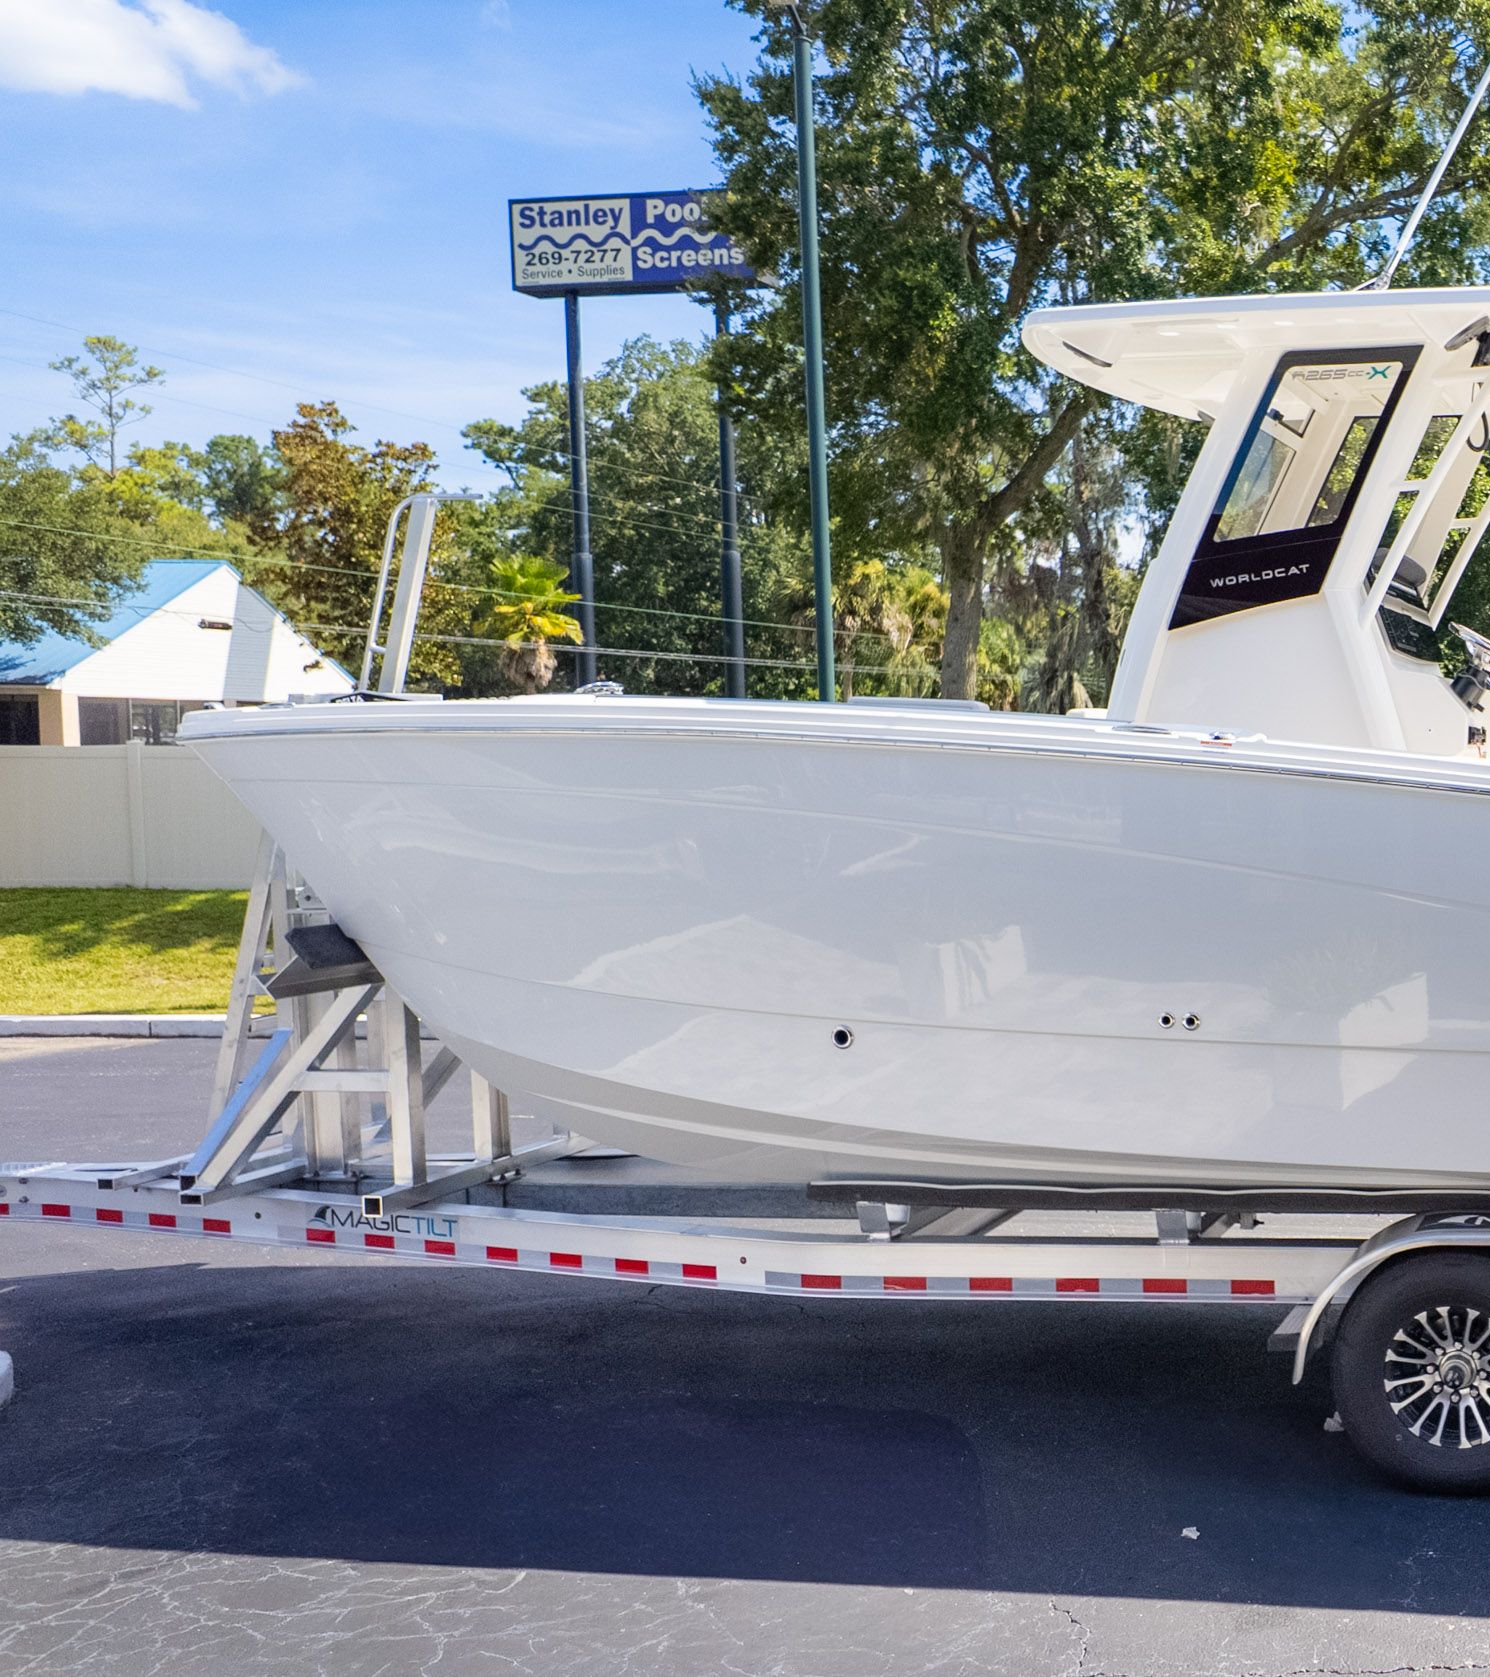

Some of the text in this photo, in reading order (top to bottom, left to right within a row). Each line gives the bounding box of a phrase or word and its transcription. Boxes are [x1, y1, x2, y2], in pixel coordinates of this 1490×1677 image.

[519, 203, 624, 231] Stanley
[645, 198, 709, 224] Poo
[525, 248, 622, 267] 269-7277
[636, 246, 745, 269] Screens
[522, 265, 625, 280] Service Supplies
[1210, 564, 1310, 588] WORLDCAT
